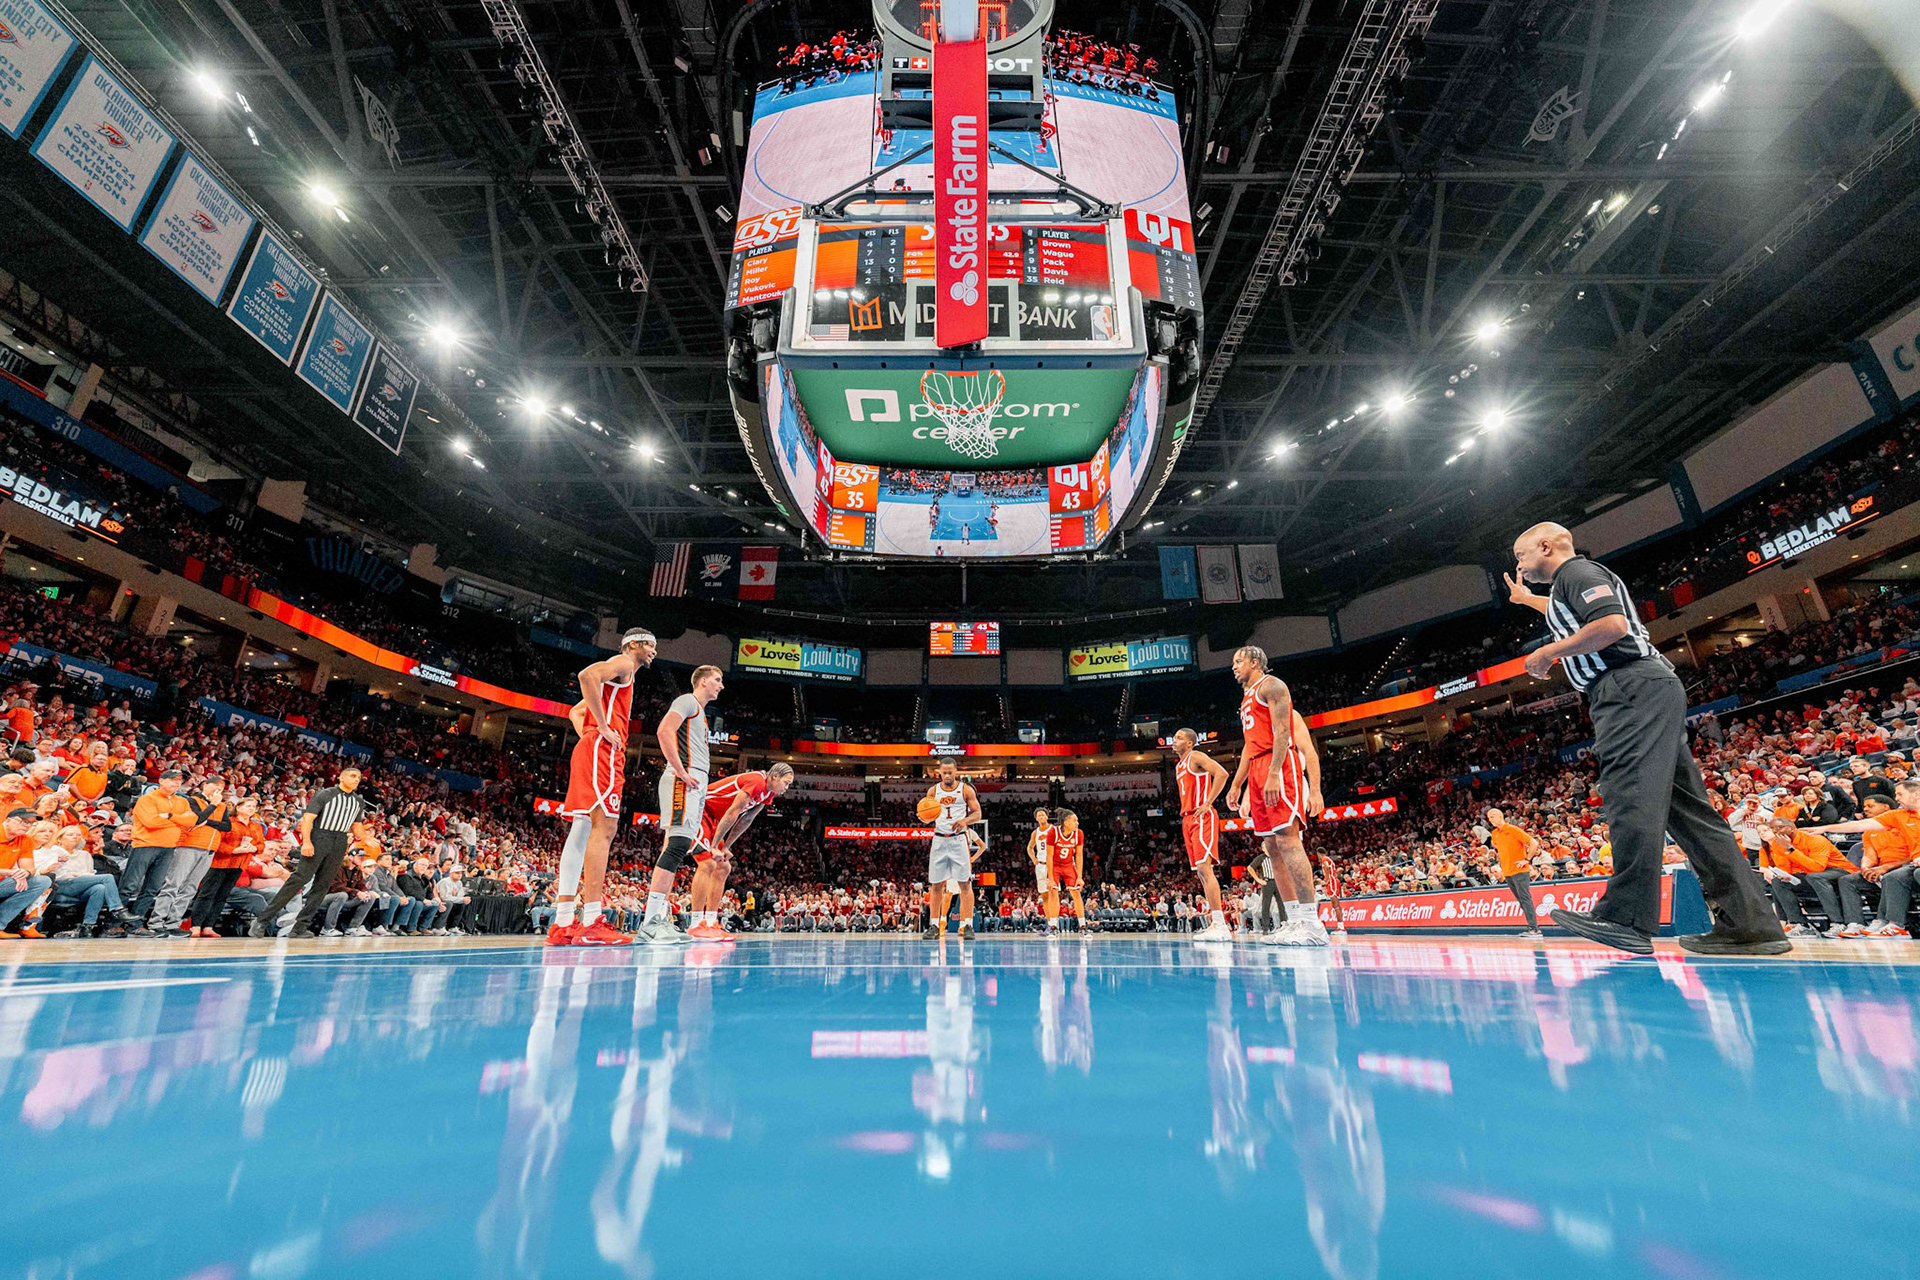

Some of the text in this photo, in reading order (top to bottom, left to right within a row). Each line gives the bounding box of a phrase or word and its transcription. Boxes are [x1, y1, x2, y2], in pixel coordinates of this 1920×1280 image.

[35, 16, 61, 41] CITY
[94, 74, 164, 143] OKLAHOMA CITY
[103, 98, 144, 144] THUNDER
[63, 126, 136, 191] NORTHWEST
[74, 123, 136, 180] 2023-2024
[57, 144, 127, 206] CHAMPIONS
[70, 144, 123, 191] DIVISION
[190, 167, 245, 225] OKLAHOMA CITY
[196, 189, 230, 226] THUNDER
[165, 218, 223, 270] NORTHWEST
[172, 214, 222, 260] 2024-2025
[1042, 230, 1069, 239] PLAYER
[1042, 240, 1071, 249] Brown
[159, 234, 215, 283] CHAMPIONS
[170, 232, 212, 271] DIVISION
[747, 257, 768, 267] Clary
[748, 245, 773, 257] PLAYER
[1042, 249, 1074, 258] Wague
[1043, 258, 1065, 267] Pack
[1161, 249, 1172, 257] PTS
[266, 242, 312, 291] OKLAHOMA CITY
[272, 262, 300, 294] THUNDER
[746, 266, 769, 276] Miller
[1043, 267, 1069, 276] Davis
[744, 277, 761, 285] Roy
[744, 282, 776, 294] Vukovic
[1043, 277, 1065, 285] Reid
[1165, 276, 1174, 284] 13
[254, 294, 289, 329] WESTERN
[255, 287, 293, 323] 2011-2012
[243, 295, 293, 341] CONFERENCE
[243, 304, 288, 345] CHAMPIONS
[328, 303, 366, 343] OKLAHOMA CITY
[333, 321, 356, 347] THUNDER
[310, 354, 351, 392] CONFERENCE
[310, 362, 347, 395] CHAMPIONS
[318, 353, 348, 380] WESTERN
[1859, 372, 1877, 399] 322
[365, 405, 398, 435] CHAMPIONS
[377, 408, 389, 420] NBA
[51, 416, 81, 441] 310
[0, 465, 102, 529] BEDLAM
[846, 490, 864, 508] 35
[1062, 491, 1080, 509] 43
[13, 493, 76, 527] BASKETBALL
[226, 514, 245, 532] 311
[1760, 505, 1851, 560] BEDLAM
[1783, 531, 1837, 559] BASKETBALL
[305, 536, 404, 595] THUNDER
[702, 553, 732, 565] THUNDER
[442, 604, 460, 619] 312
[557, 638, 572, 650] 313
[1131, 643, 1188, 666] LOUD CITY
[782, 669, 813, 678] THUNDER
[803, 650, 859, 672] LOUD CITY
[1112, 670, 1143, 678] THUNDER
[832, 782, 858, 790] TERRACE
[1107, 781, 1126, 789] PARTY
[1128, 780, 1153, 788] TERRACE
[1180, 779, 1185, 795] 1
[945, 807, 952, 820] 1
[1040, 842, 1045, 850] 9
[1059, 848, 1069, 859] 9
